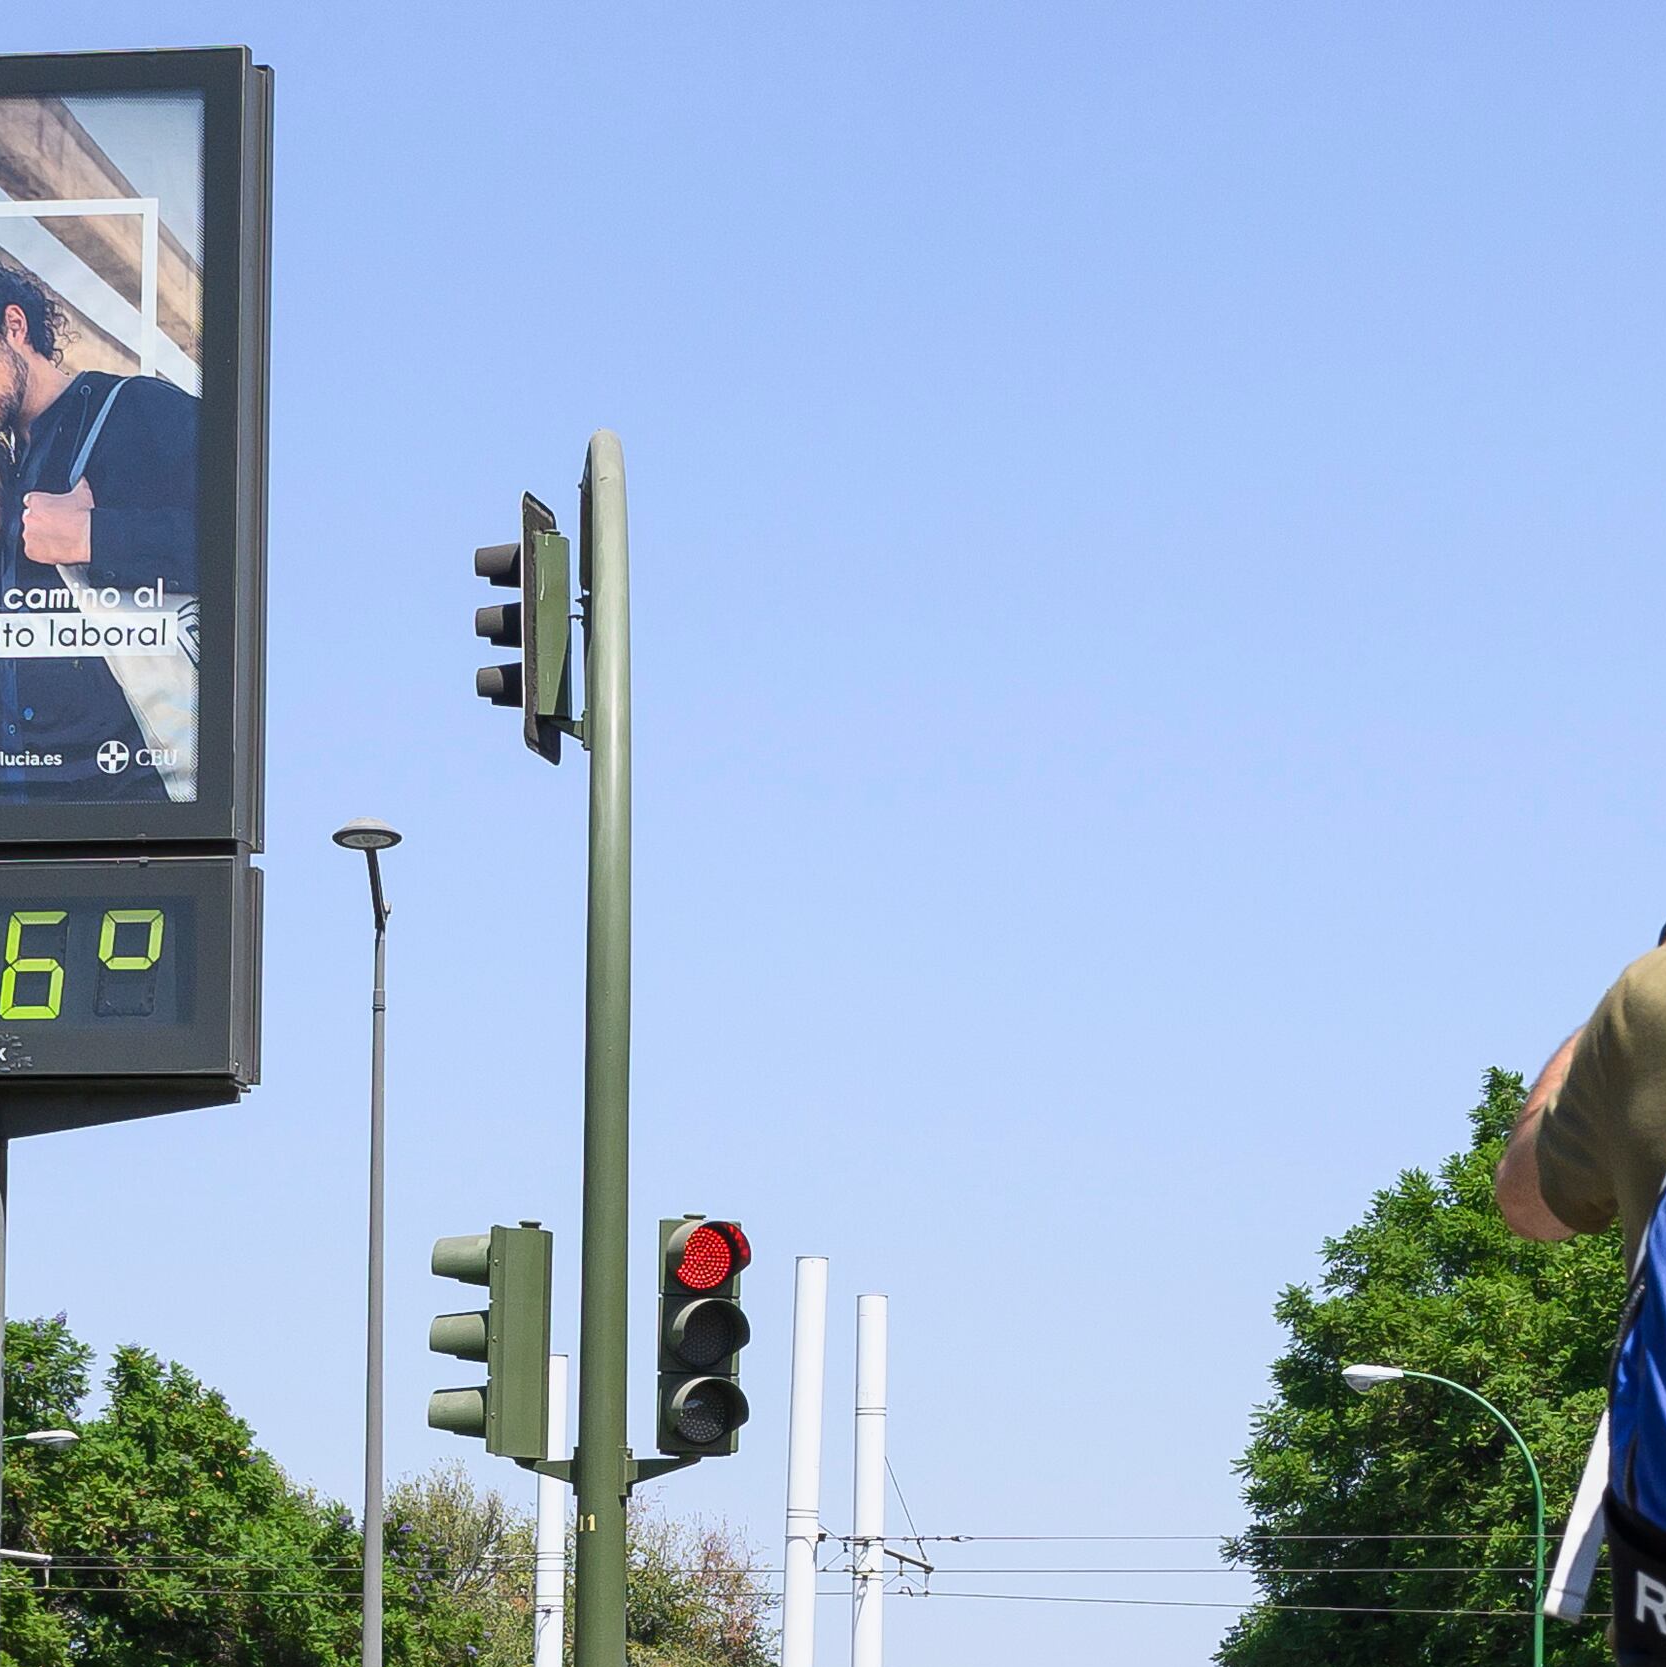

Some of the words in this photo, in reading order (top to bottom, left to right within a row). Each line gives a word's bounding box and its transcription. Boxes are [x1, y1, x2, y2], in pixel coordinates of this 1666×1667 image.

[2, 581, 122, 610] camino
[133, 576, 165, 609] al
[49, 618, 167, 647] laboral
[134, 748, 179, 768] CEU
